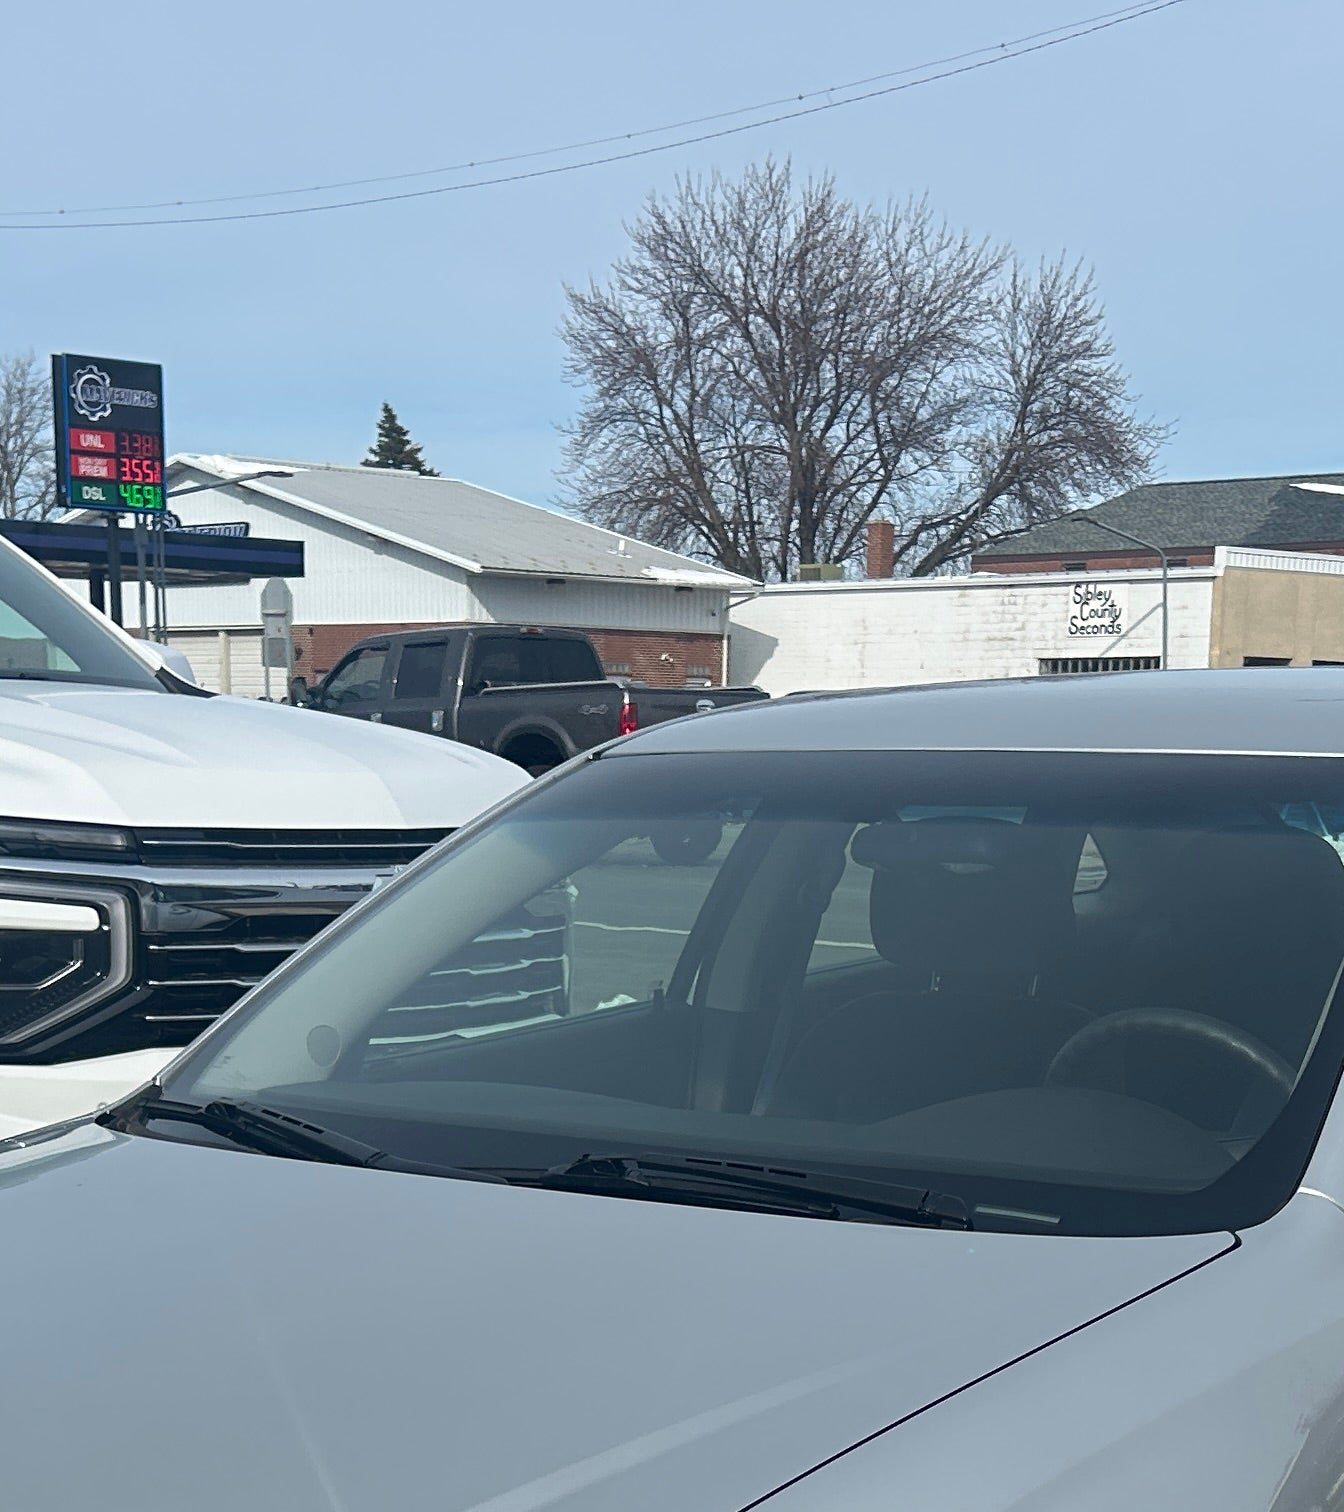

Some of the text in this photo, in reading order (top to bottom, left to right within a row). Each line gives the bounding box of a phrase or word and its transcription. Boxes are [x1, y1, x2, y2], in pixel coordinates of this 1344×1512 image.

[82, 486, 106, 500] DSL
[1072, 584, 1112, 607] Sibley
[1080, 600, 1122, 623] County
[1068, 615, 1122, 635] Seconds
